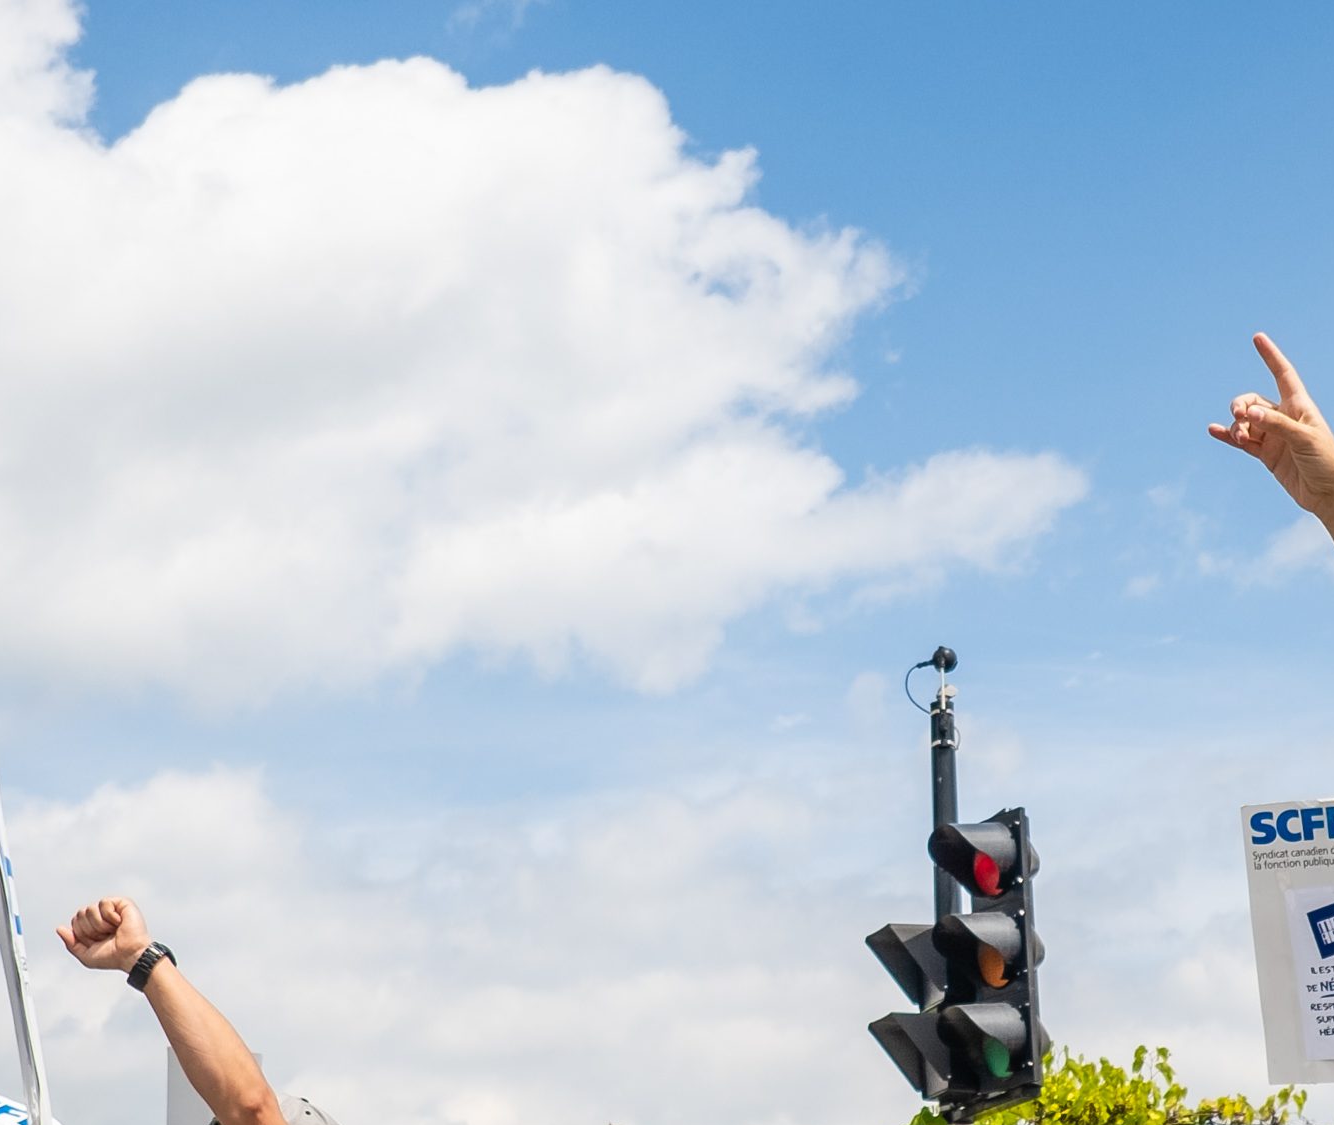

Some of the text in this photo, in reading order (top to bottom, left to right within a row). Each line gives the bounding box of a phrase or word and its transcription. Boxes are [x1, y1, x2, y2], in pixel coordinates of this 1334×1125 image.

[1252, 849, 1288, 861] Syndicat
[1291, 847, 1328, 858] canadien
[1254, 862, 1262, 870] la
[1264, 859, 1301, 869] fonction
[1311, 966, 1318, 974] IL
[1306, 984, 1318, 992] DE
